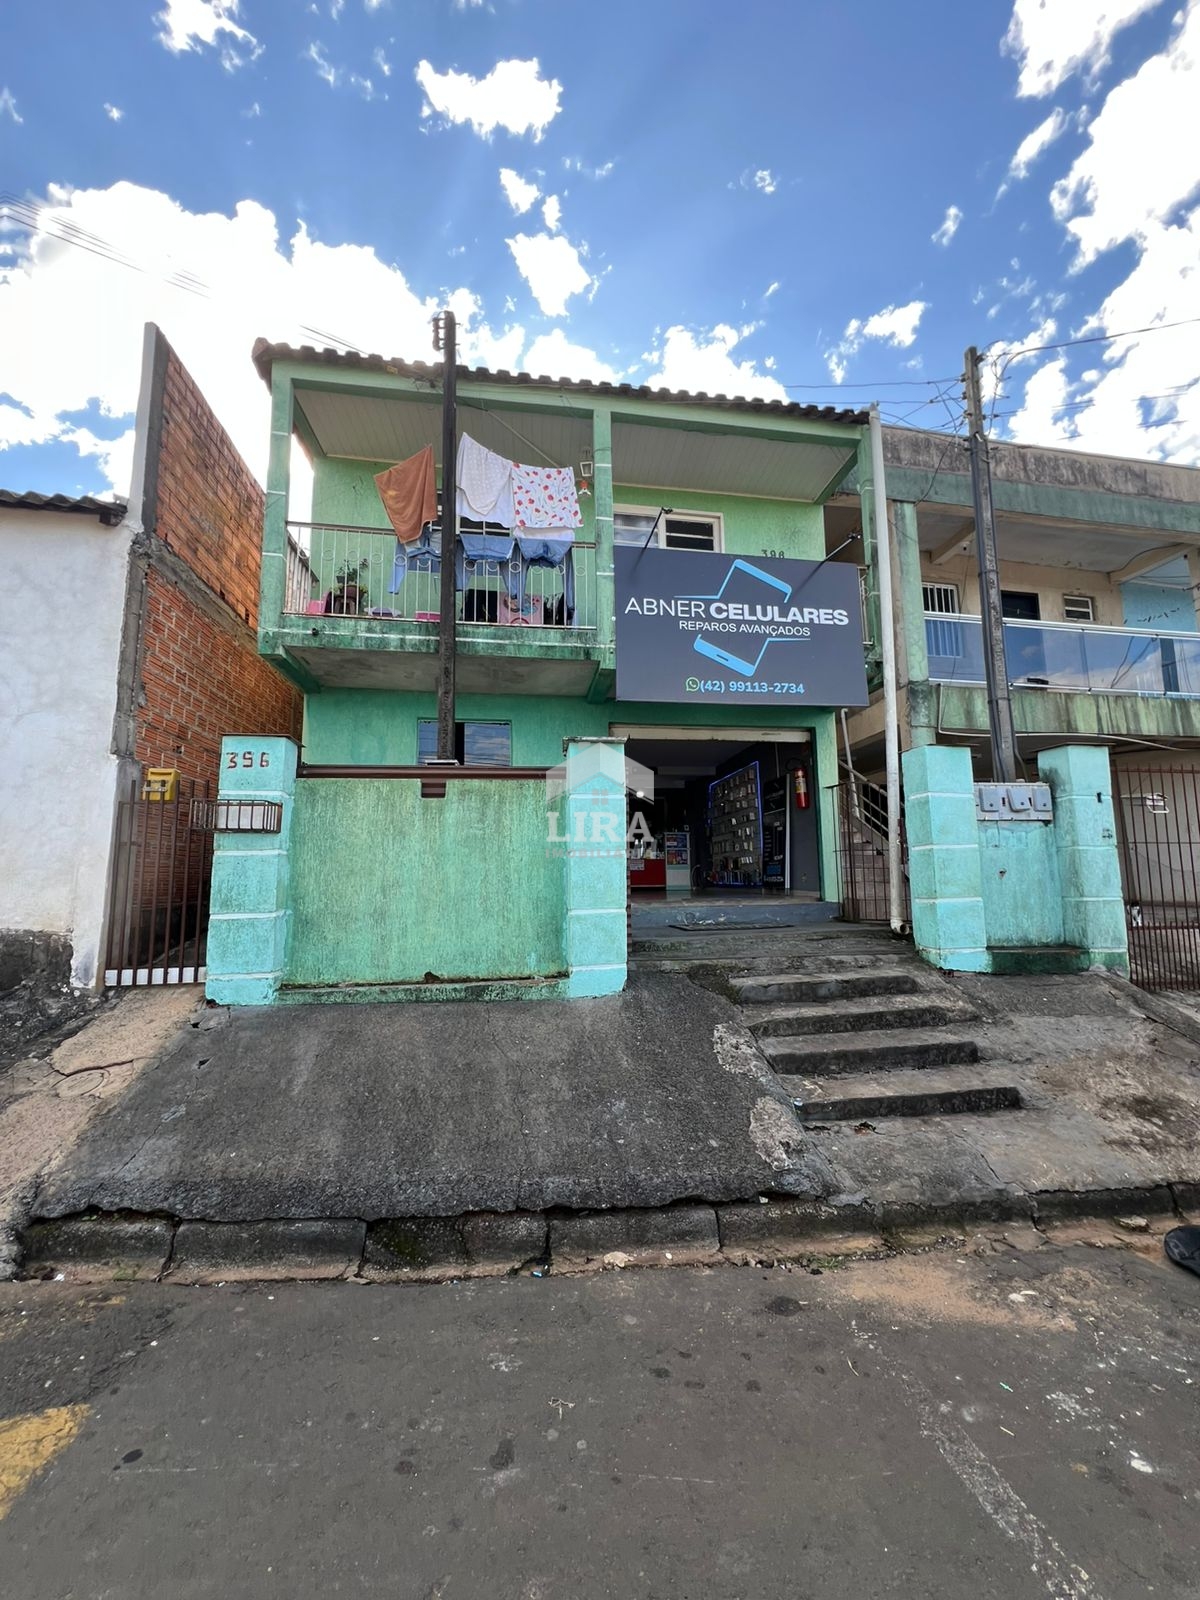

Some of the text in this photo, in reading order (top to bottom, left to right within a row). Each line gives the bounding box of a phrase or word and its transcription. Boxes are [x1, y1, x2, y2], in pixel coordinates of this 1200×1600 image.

[624, 597, 849, 626] ABNER CELULARES
[679, 620, 811, 637] REPAROS AVANÇADOS
[700, 680, 805, 695] (42) 99113-2734
